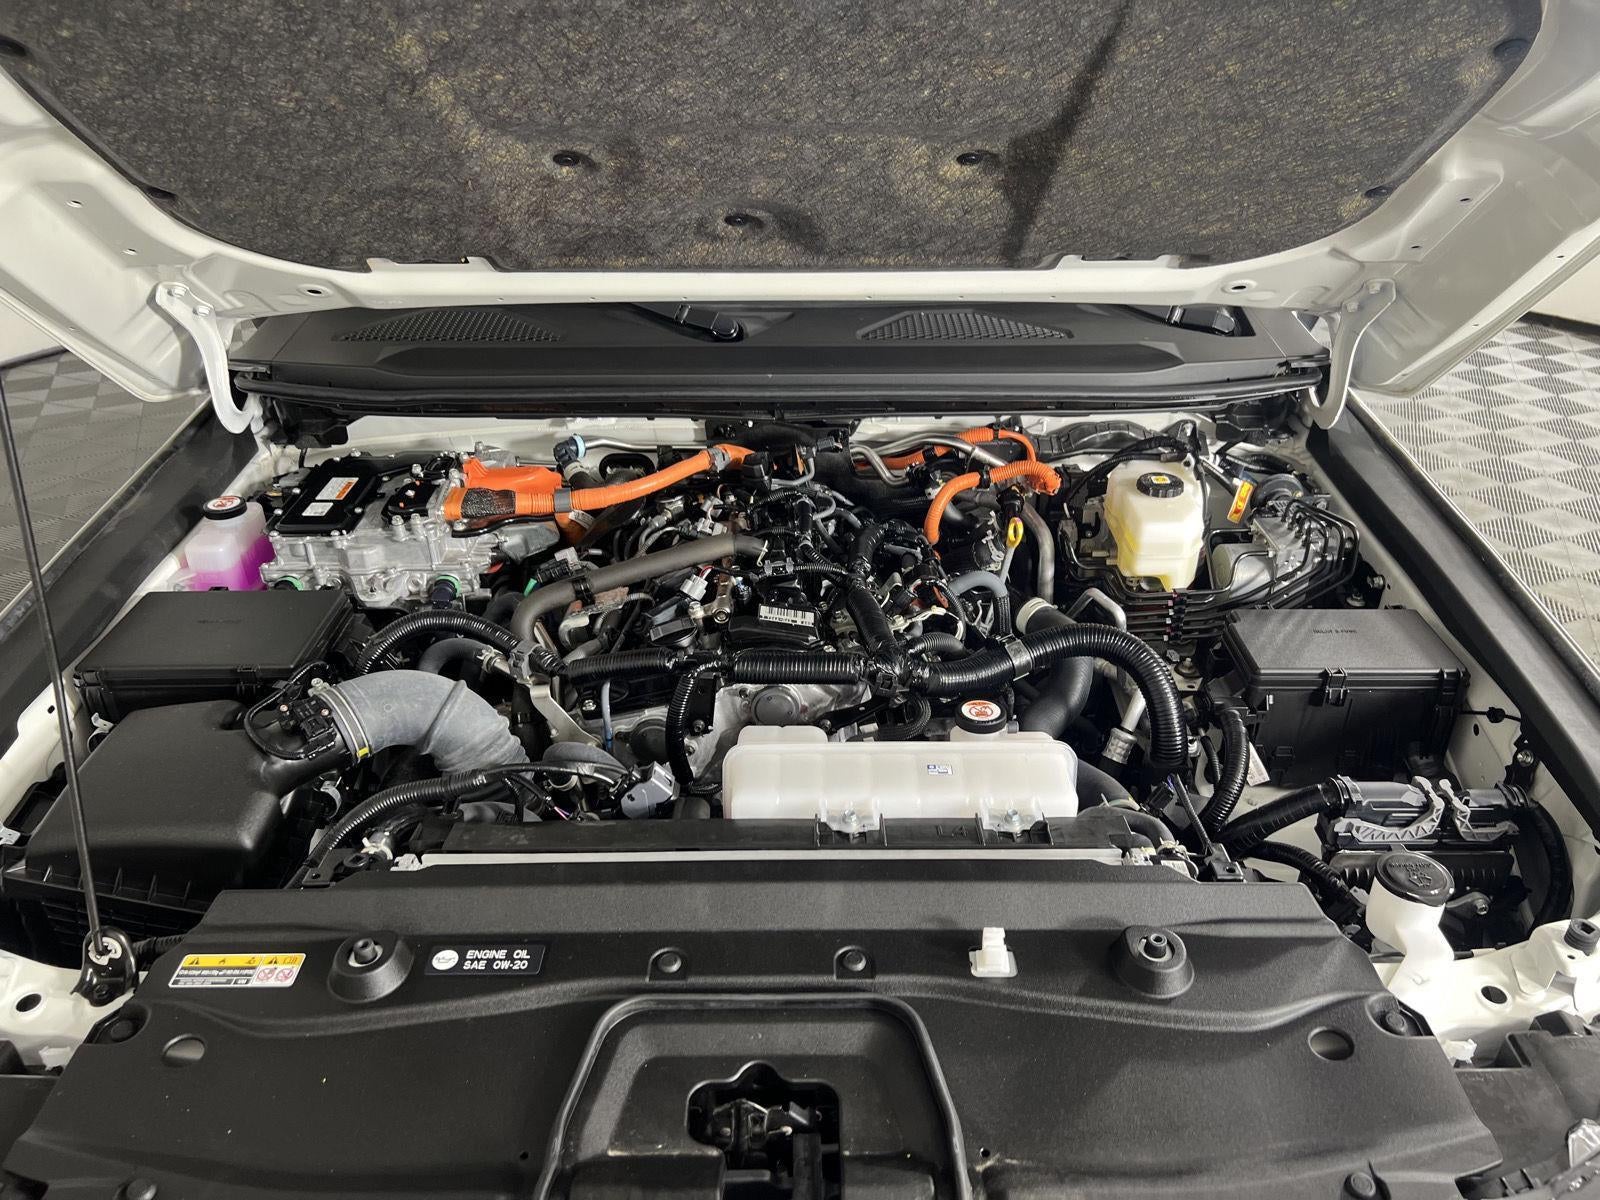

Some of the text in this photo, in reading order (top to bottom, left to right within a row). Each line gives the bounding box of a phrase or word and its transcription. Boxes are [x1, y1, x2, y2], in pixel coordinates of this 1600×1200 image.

[466, 949, 531, 959] ENGINE OIL
[463, 960, 528, 970] SAE 0W-20
